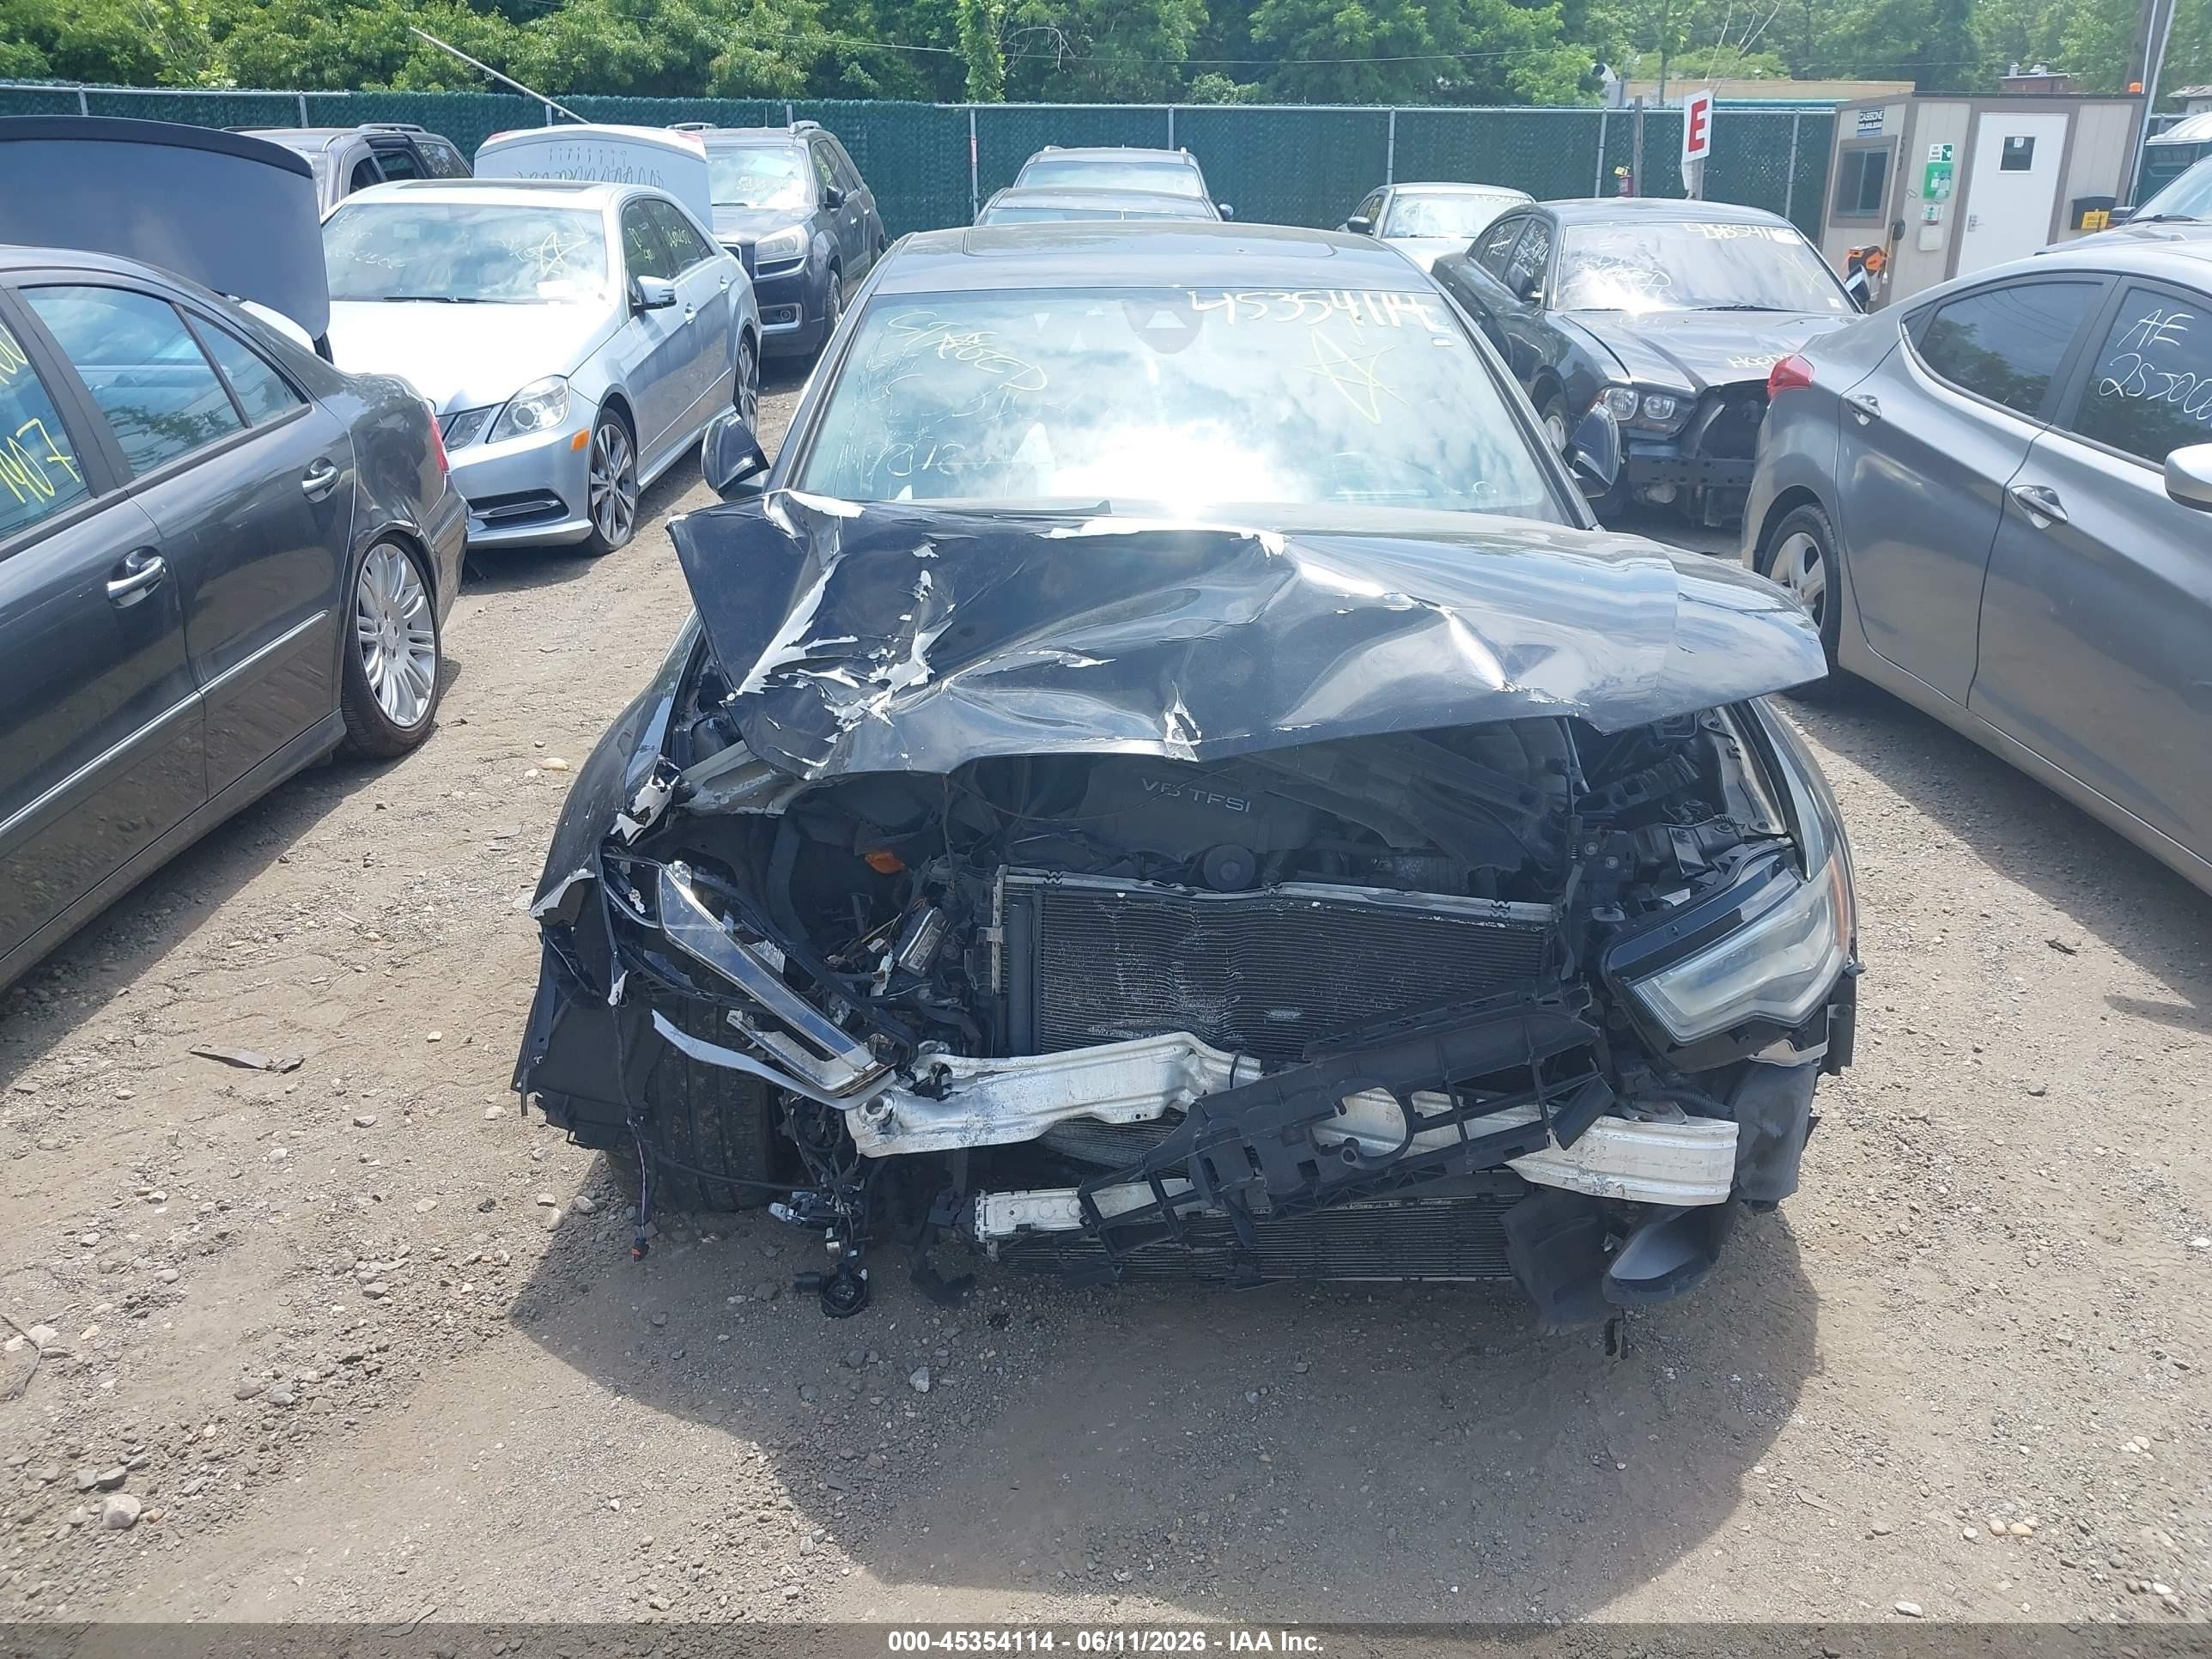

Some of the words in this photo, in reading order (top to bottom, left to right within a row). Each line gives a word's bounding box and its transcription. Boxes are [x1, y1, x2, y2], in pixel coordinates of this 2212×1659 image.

[1688, 98, 1708, 153] E
[2116, 308, 2196, 350] AE
[1188, 787, 1251, 812] TFSI
